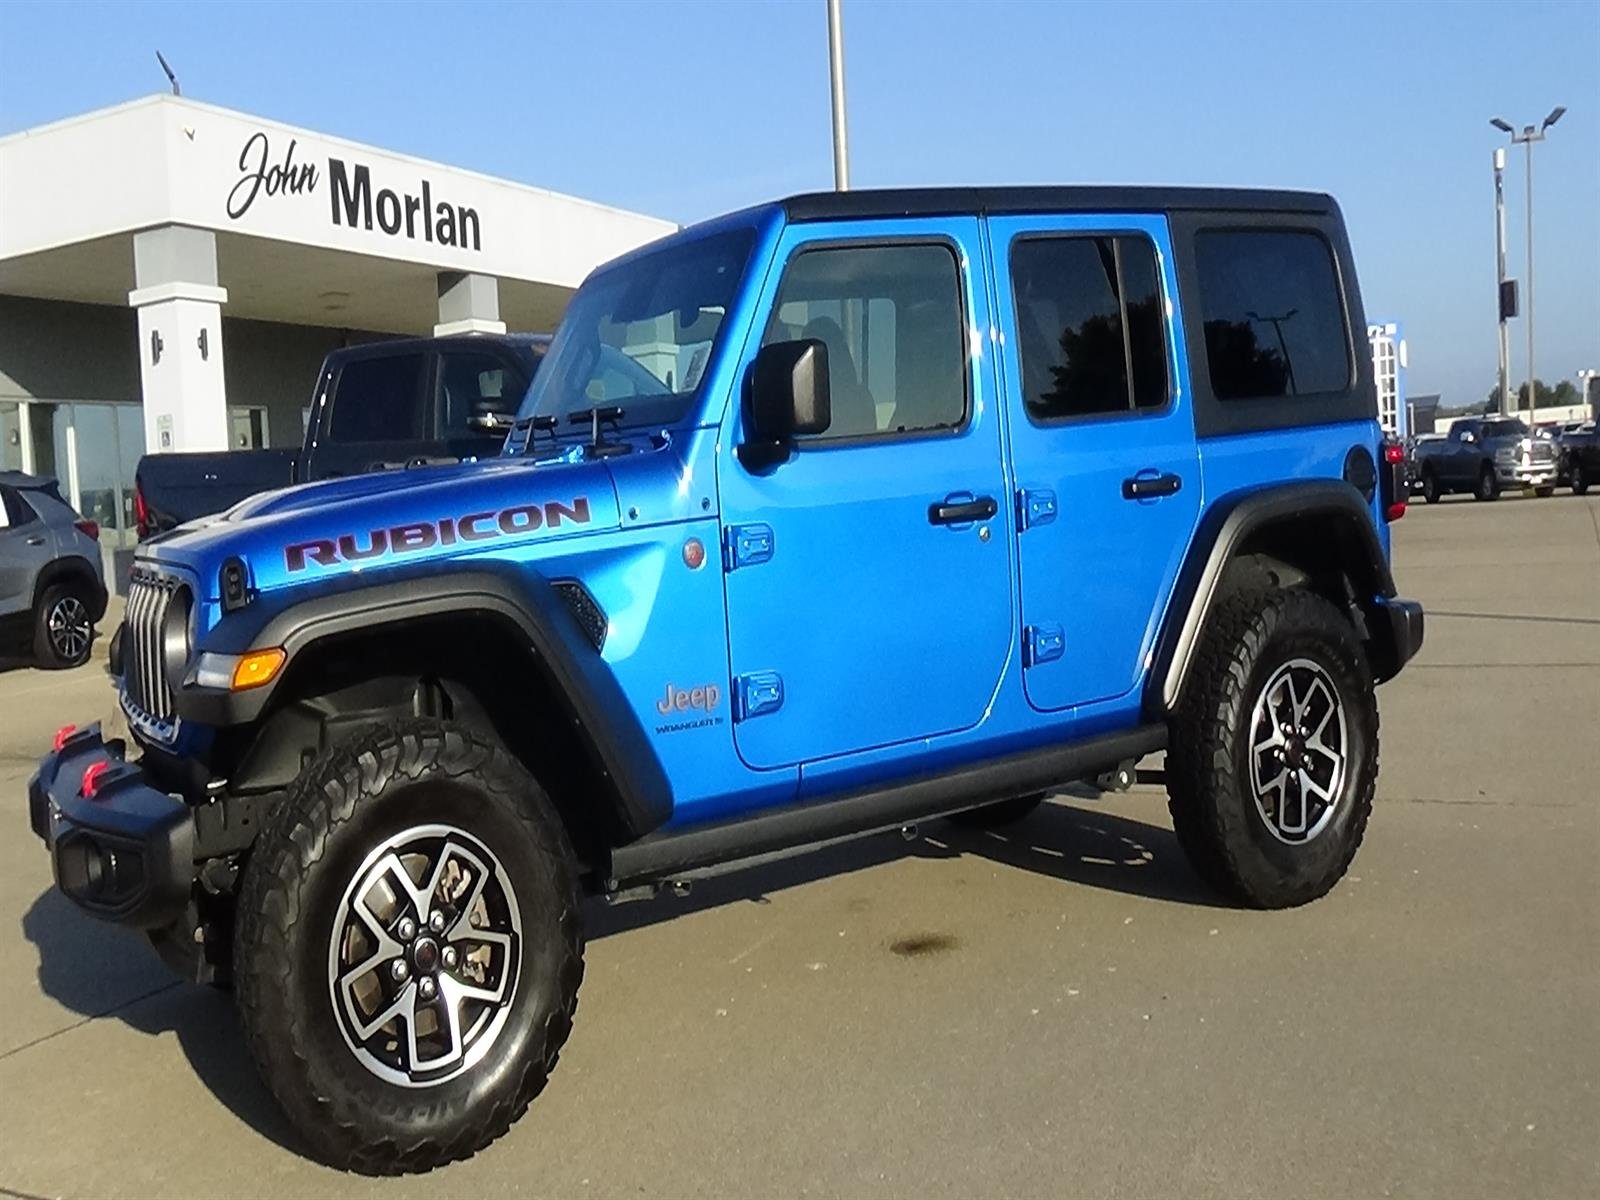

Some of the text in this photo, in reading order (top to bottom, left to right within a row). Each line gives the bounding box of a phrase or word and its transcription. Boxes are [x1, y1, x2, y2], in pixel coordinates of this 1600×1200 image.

[226, 132, 481, 251] John Morlan
[285, 496, 590, 572] RUBICON
[657, 682, 720, 716] Jeep
